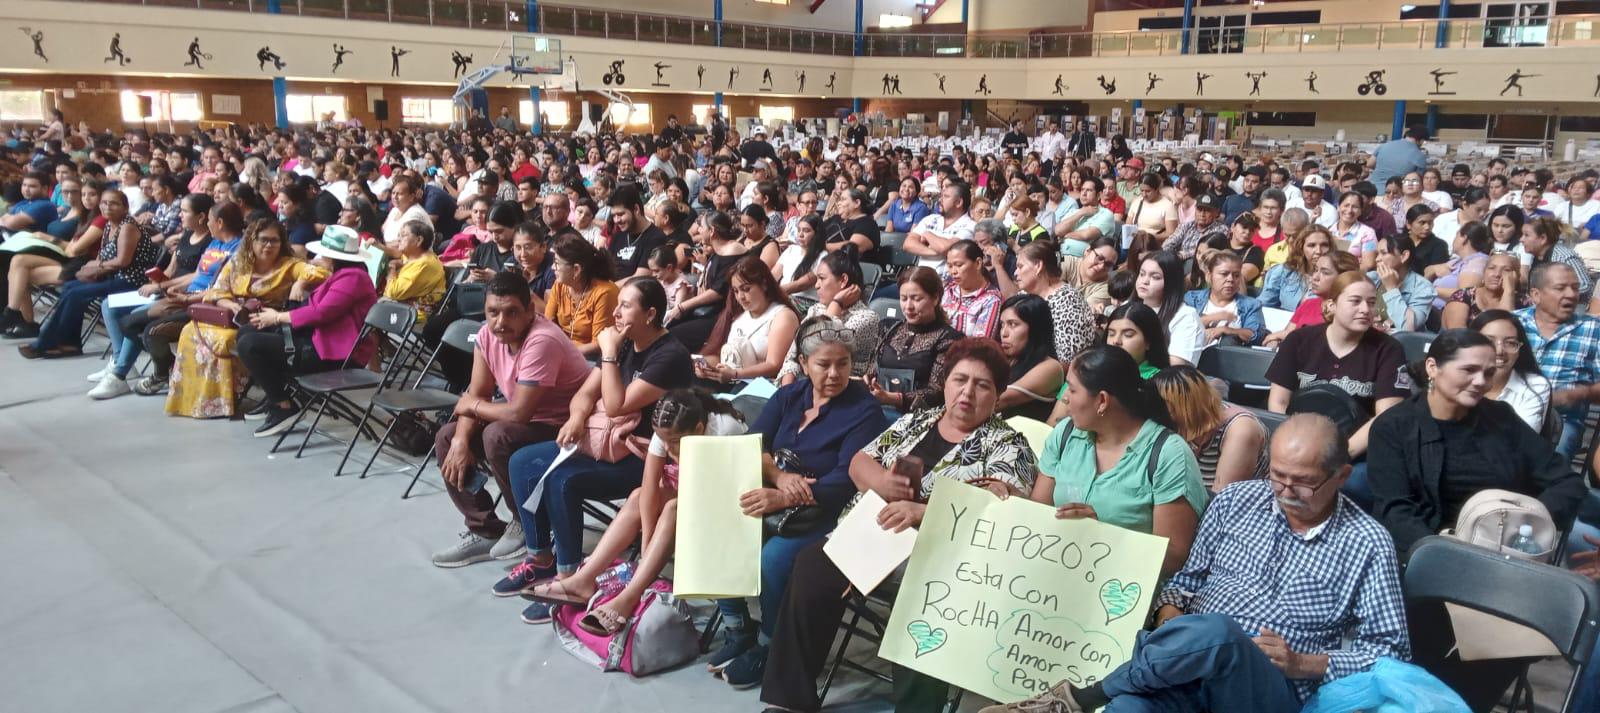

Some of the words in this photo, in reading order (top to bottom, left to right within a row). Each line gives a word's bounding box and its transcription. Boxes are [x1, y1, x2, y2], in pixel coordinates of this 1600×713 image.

[950, 503, 967, 541] Y
[970, 518, 998, 550] EL
[1005, 525, 1112, 583] POZO?
[956, 562, 1003, 590] Esta
[1008, 575, 1058, 611] Con
[1007, 643, 1062, 673] Amor
[1014, 613, 1076, 652] Amor
[1080, 642, 1111, 669] Con
